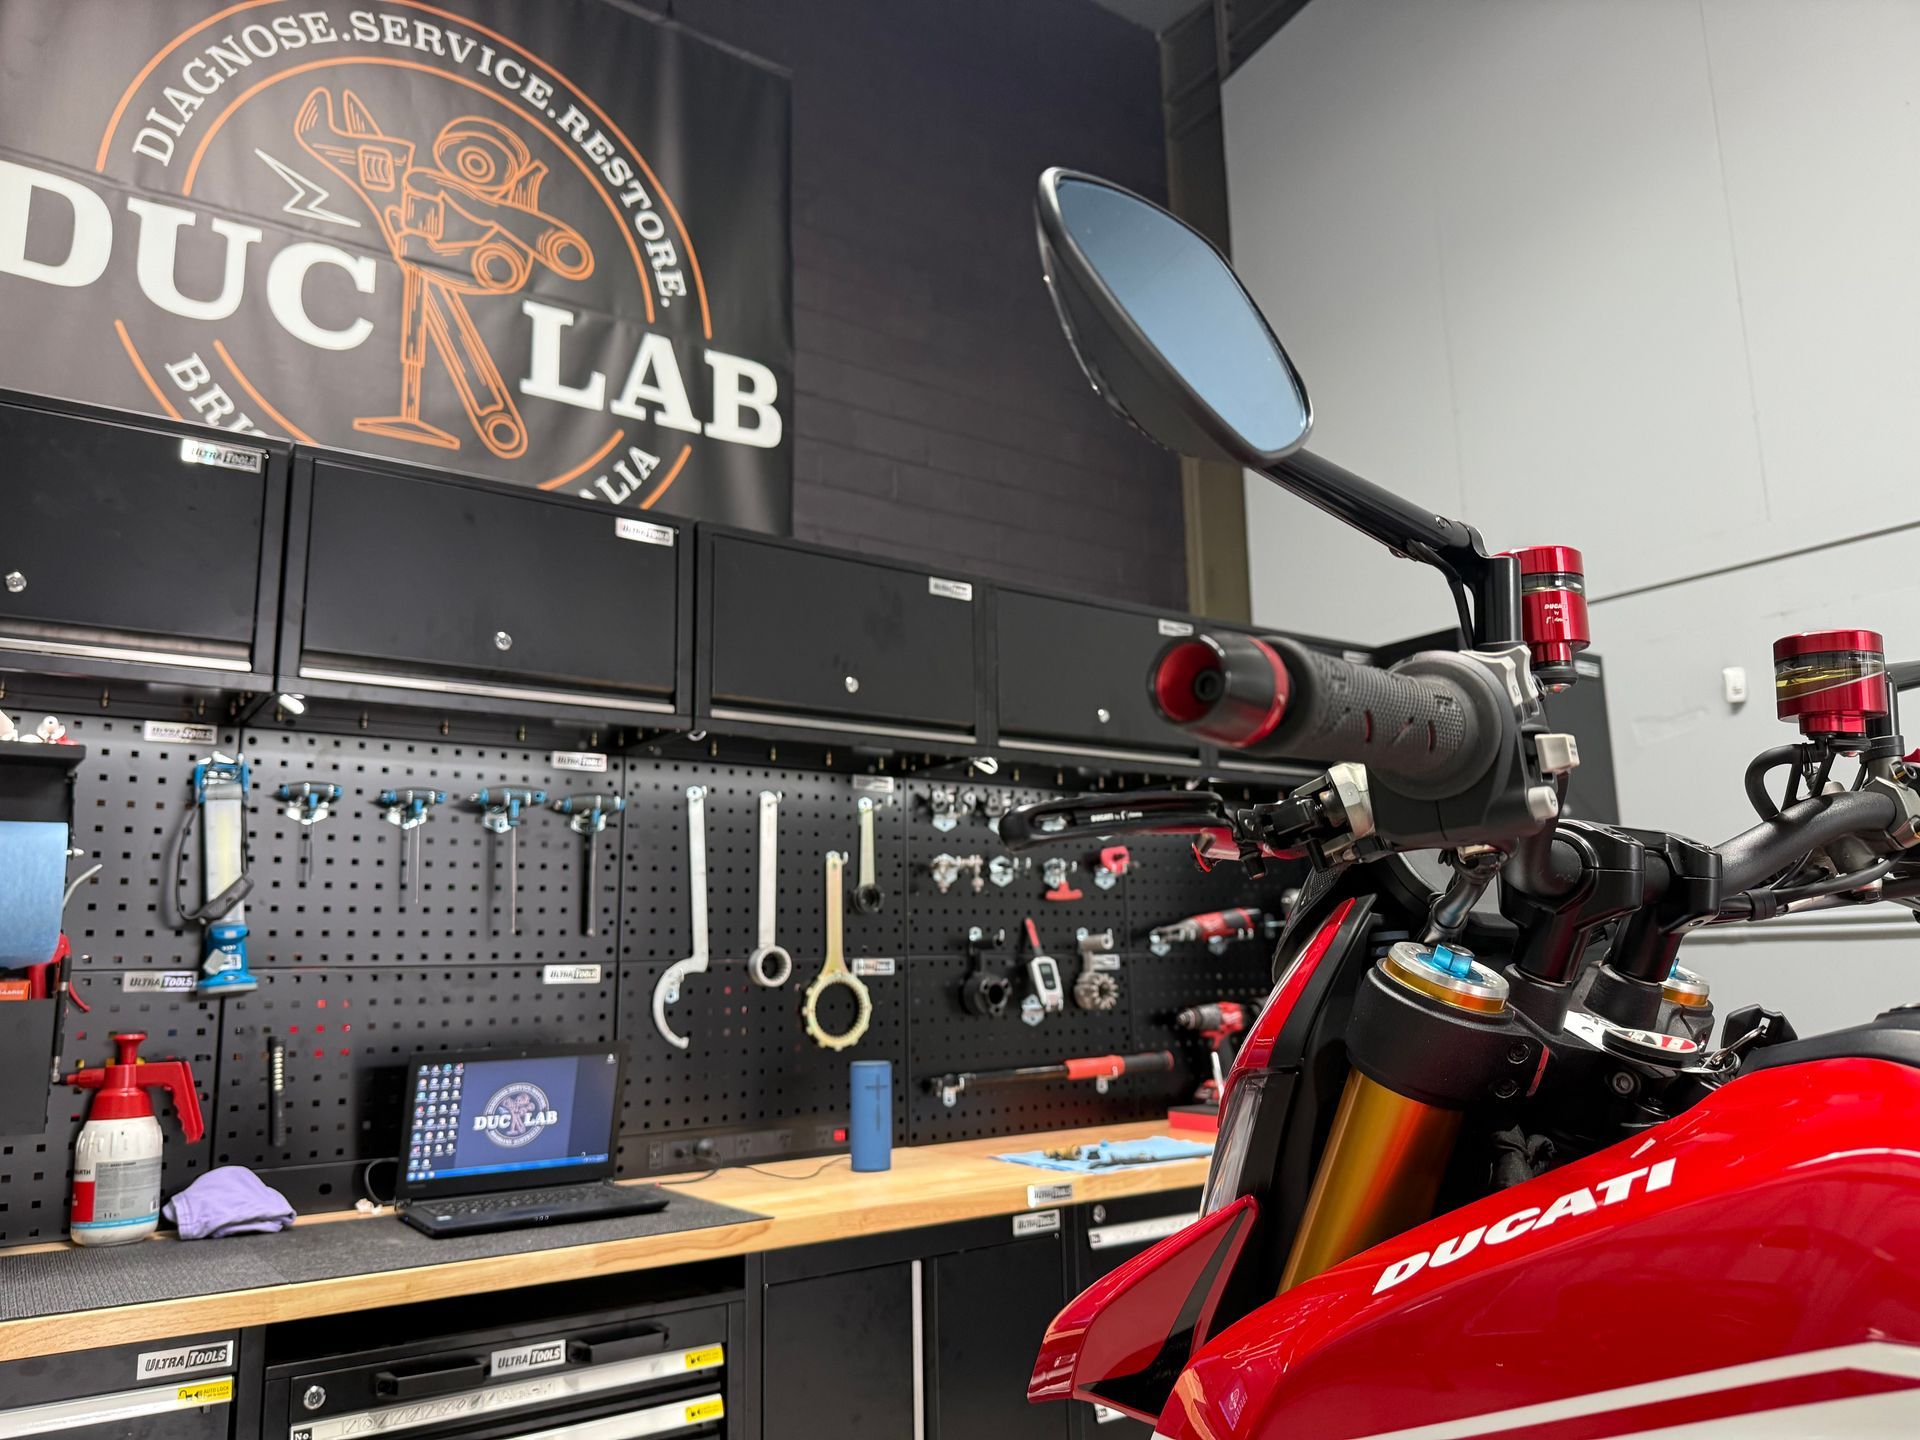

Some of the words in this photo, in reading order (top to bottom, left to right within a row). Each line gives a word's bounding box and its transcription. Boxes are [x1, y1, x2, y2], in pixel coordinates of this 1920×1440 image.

[0, 160, 376, 351] DUC
[519, 299, 782, 448] LAB
[473, 1114, 512, 1131] DUC
[524, 1110, 558, 1127] LAB
[1372, 1157, 1677, 1296] DUCATI
[145, 1355, 185, 1372] ULTRA
[187, 1347, 228, 1367] TOOLS
[498, 1354, 528, 1368] ULTRA
[531, 1347, 561, 1365] TOOLS
